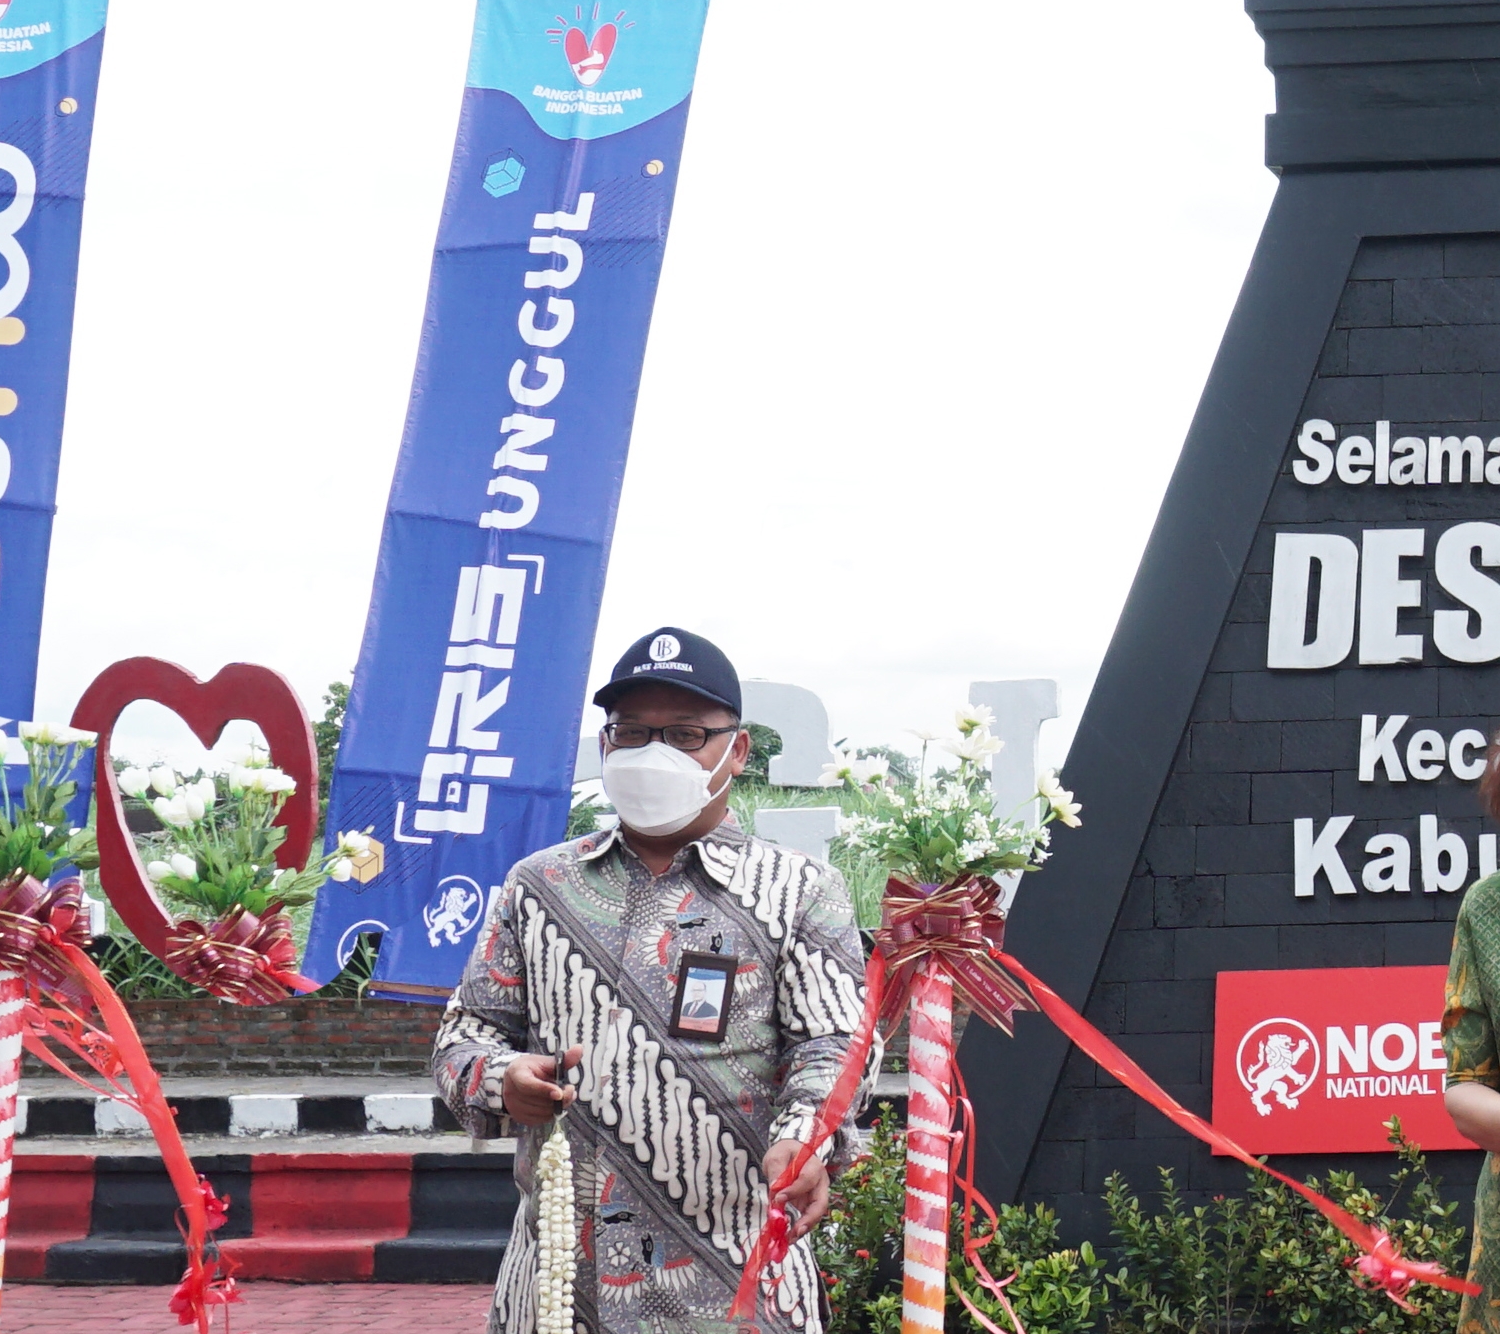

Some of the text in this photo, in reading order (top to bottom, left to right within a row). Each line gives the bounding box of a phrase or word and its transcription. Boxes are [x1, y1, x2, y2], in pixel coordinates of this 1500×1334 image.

[533, 85, 642, 102] BANGGA BUATAN
[545, 101, 623, 115] INDONESIA
[480, 191, 595, 530] UNGGUL
[1326, 1074, 1437, 1099] NATIONAL
